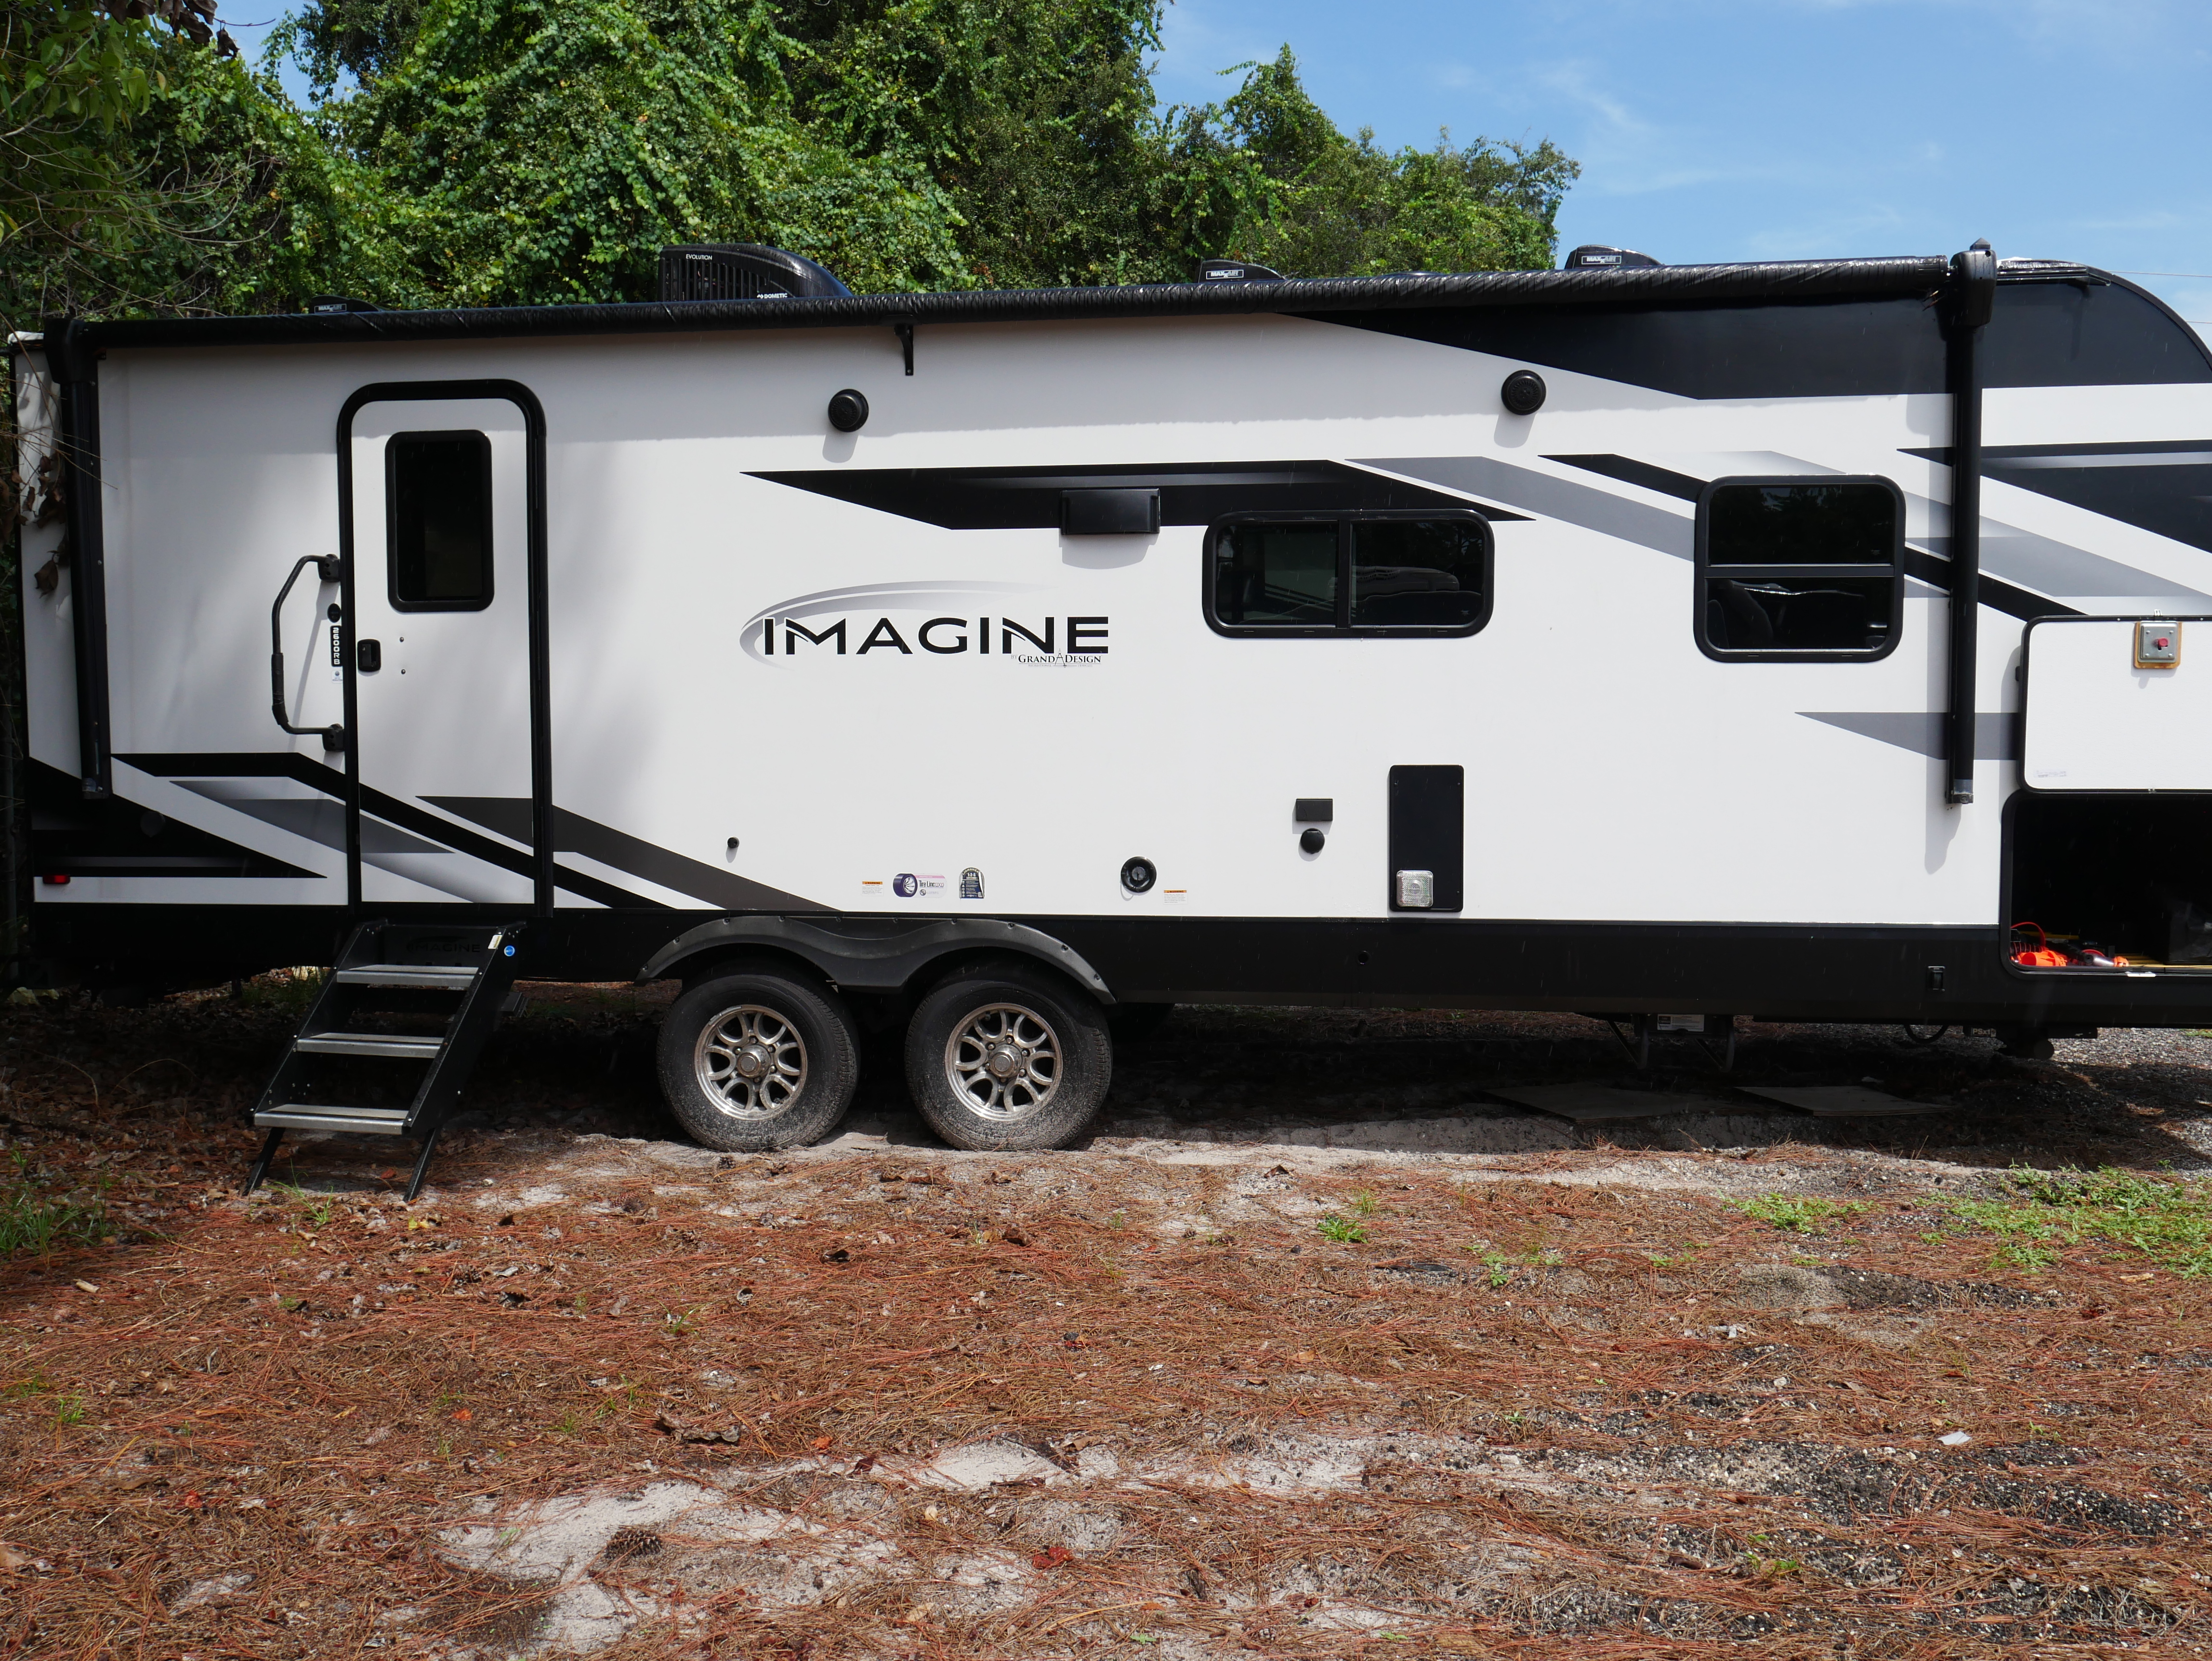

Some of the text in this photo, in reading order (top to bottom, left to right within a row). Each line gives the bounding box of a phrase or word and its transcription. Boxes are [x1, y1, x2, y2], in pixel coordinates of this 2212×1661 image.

[332, 627, 341, 665] 2600RB
[764, 616, 1109, 655] IMAGINE
[1018, 654, 1055, 663] GRAND
[1065, 654, 1101, 663] DESIGN
[410, 943, 481, 953] IMAGINE
